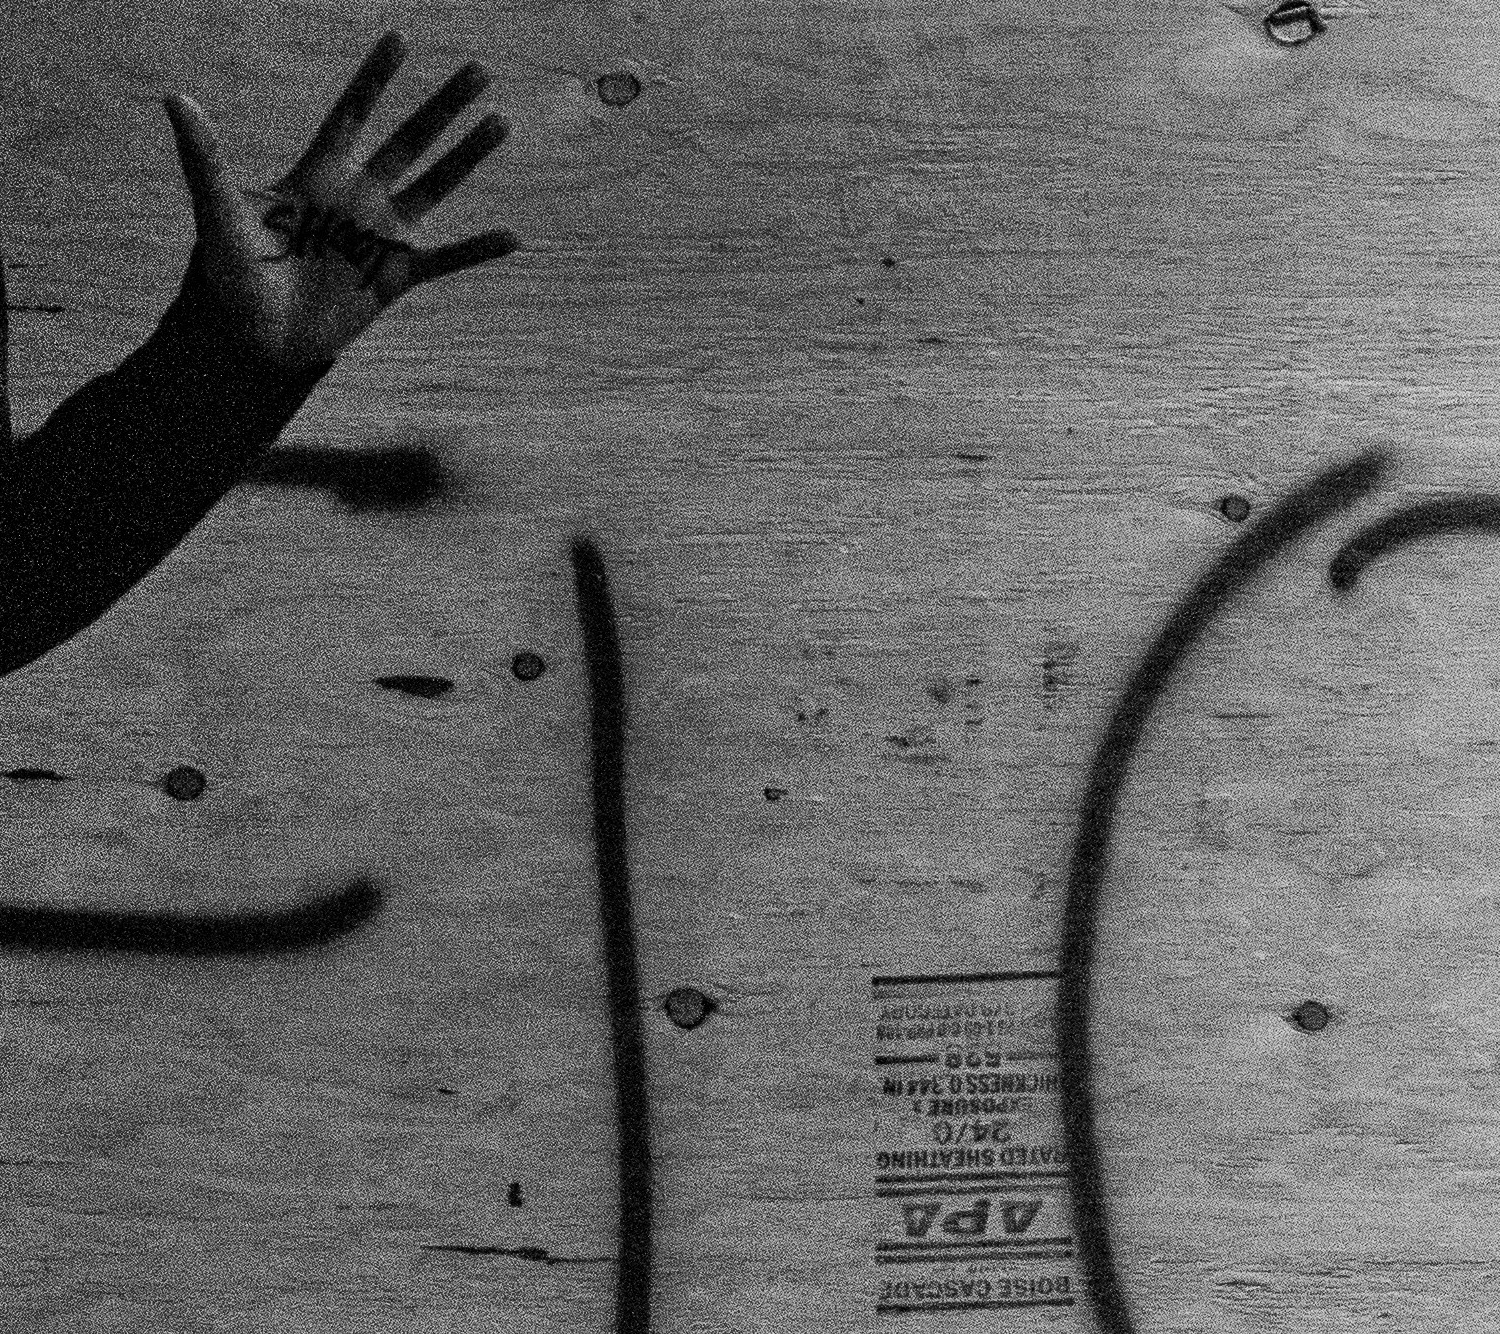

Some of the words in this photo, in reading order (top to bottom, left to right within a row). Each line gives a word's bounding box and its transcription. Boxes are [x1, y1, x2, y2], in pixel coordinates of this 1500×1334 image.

[965, 1073, 1060, 1095] HICKNESS
[932, 1120, 1012, 1145] 24/0
[875, 1147, 996, 1170] SHEATHING
[901, 1198, 1043, 1238] APA
[878, 1278, 992, 1301] CASCADE
[999, 1276, 1071, 1299] BOISE
